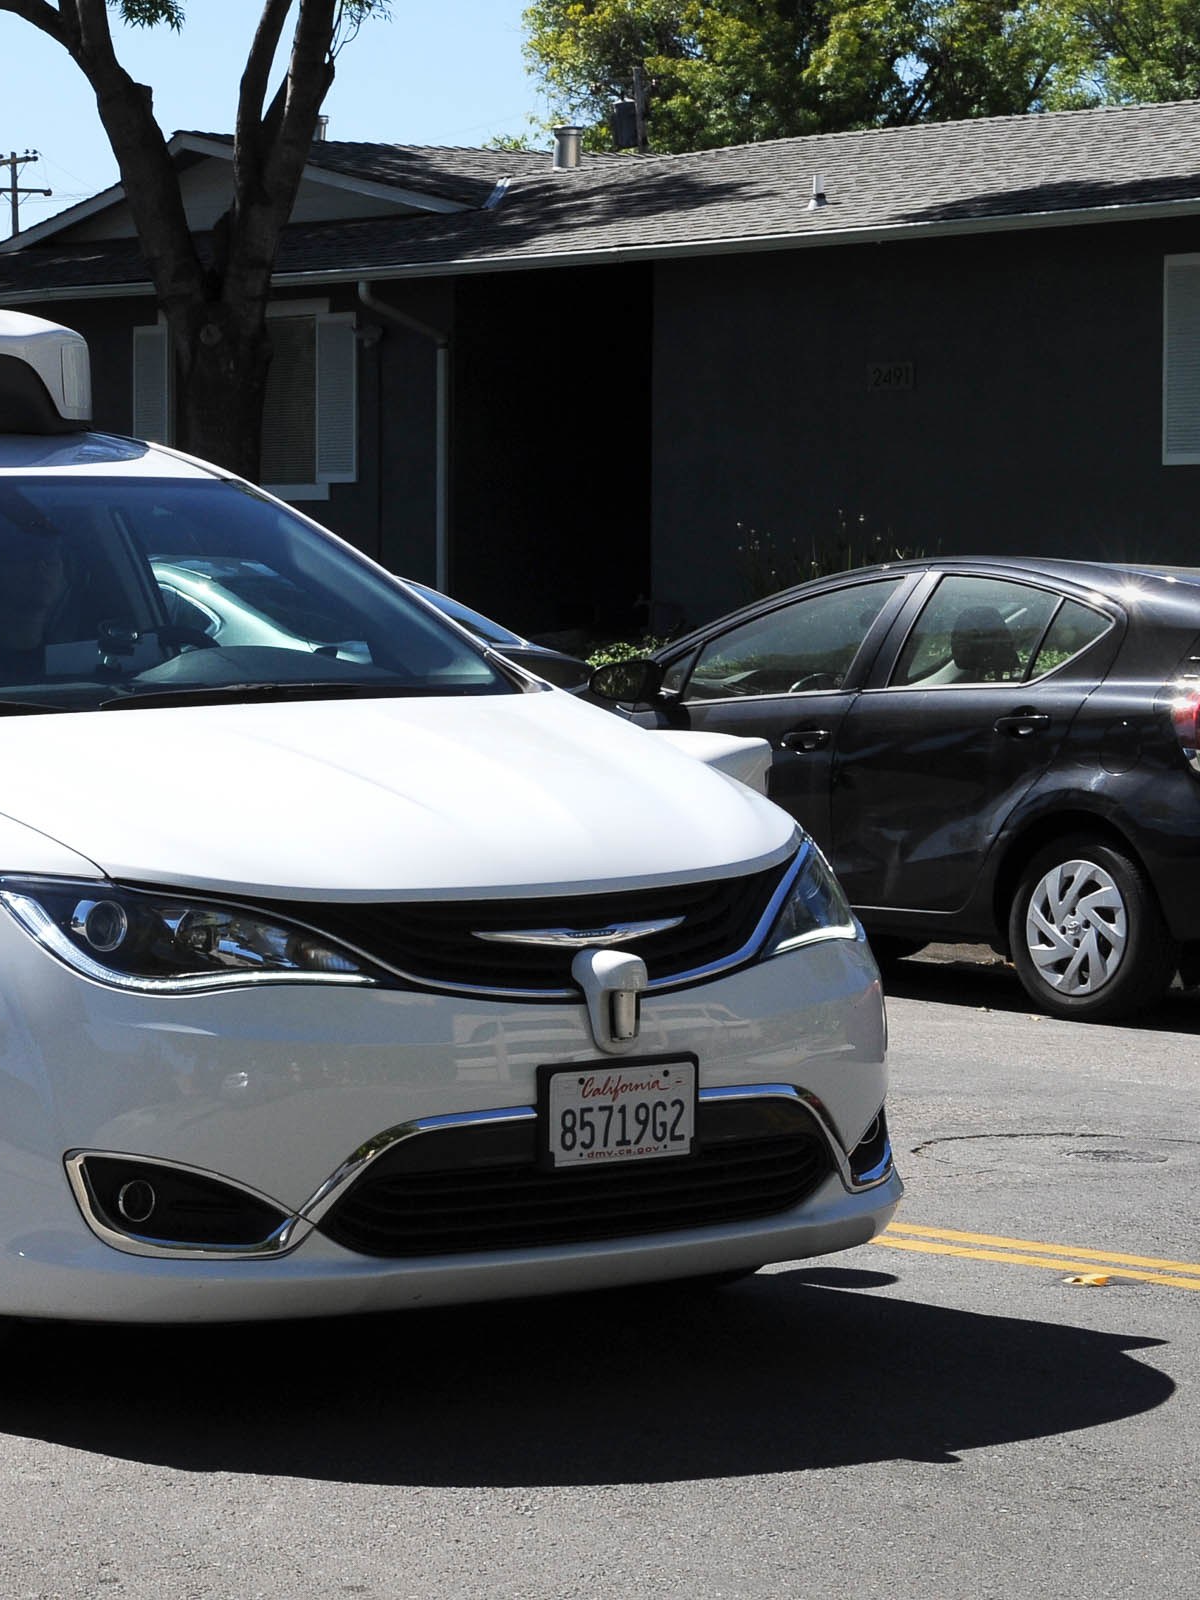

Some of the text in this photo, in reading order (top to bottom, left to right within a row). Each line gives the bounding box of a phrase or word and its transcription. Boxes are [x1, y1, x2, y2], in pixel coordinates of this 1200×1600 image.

[872, 366, 910, 387] 2491
[581, 1074, 670, 1102] California
[560, 1098, 685, 1151] 85719G2
[587, 1145, 660, 1159] dmv.ca.gov
